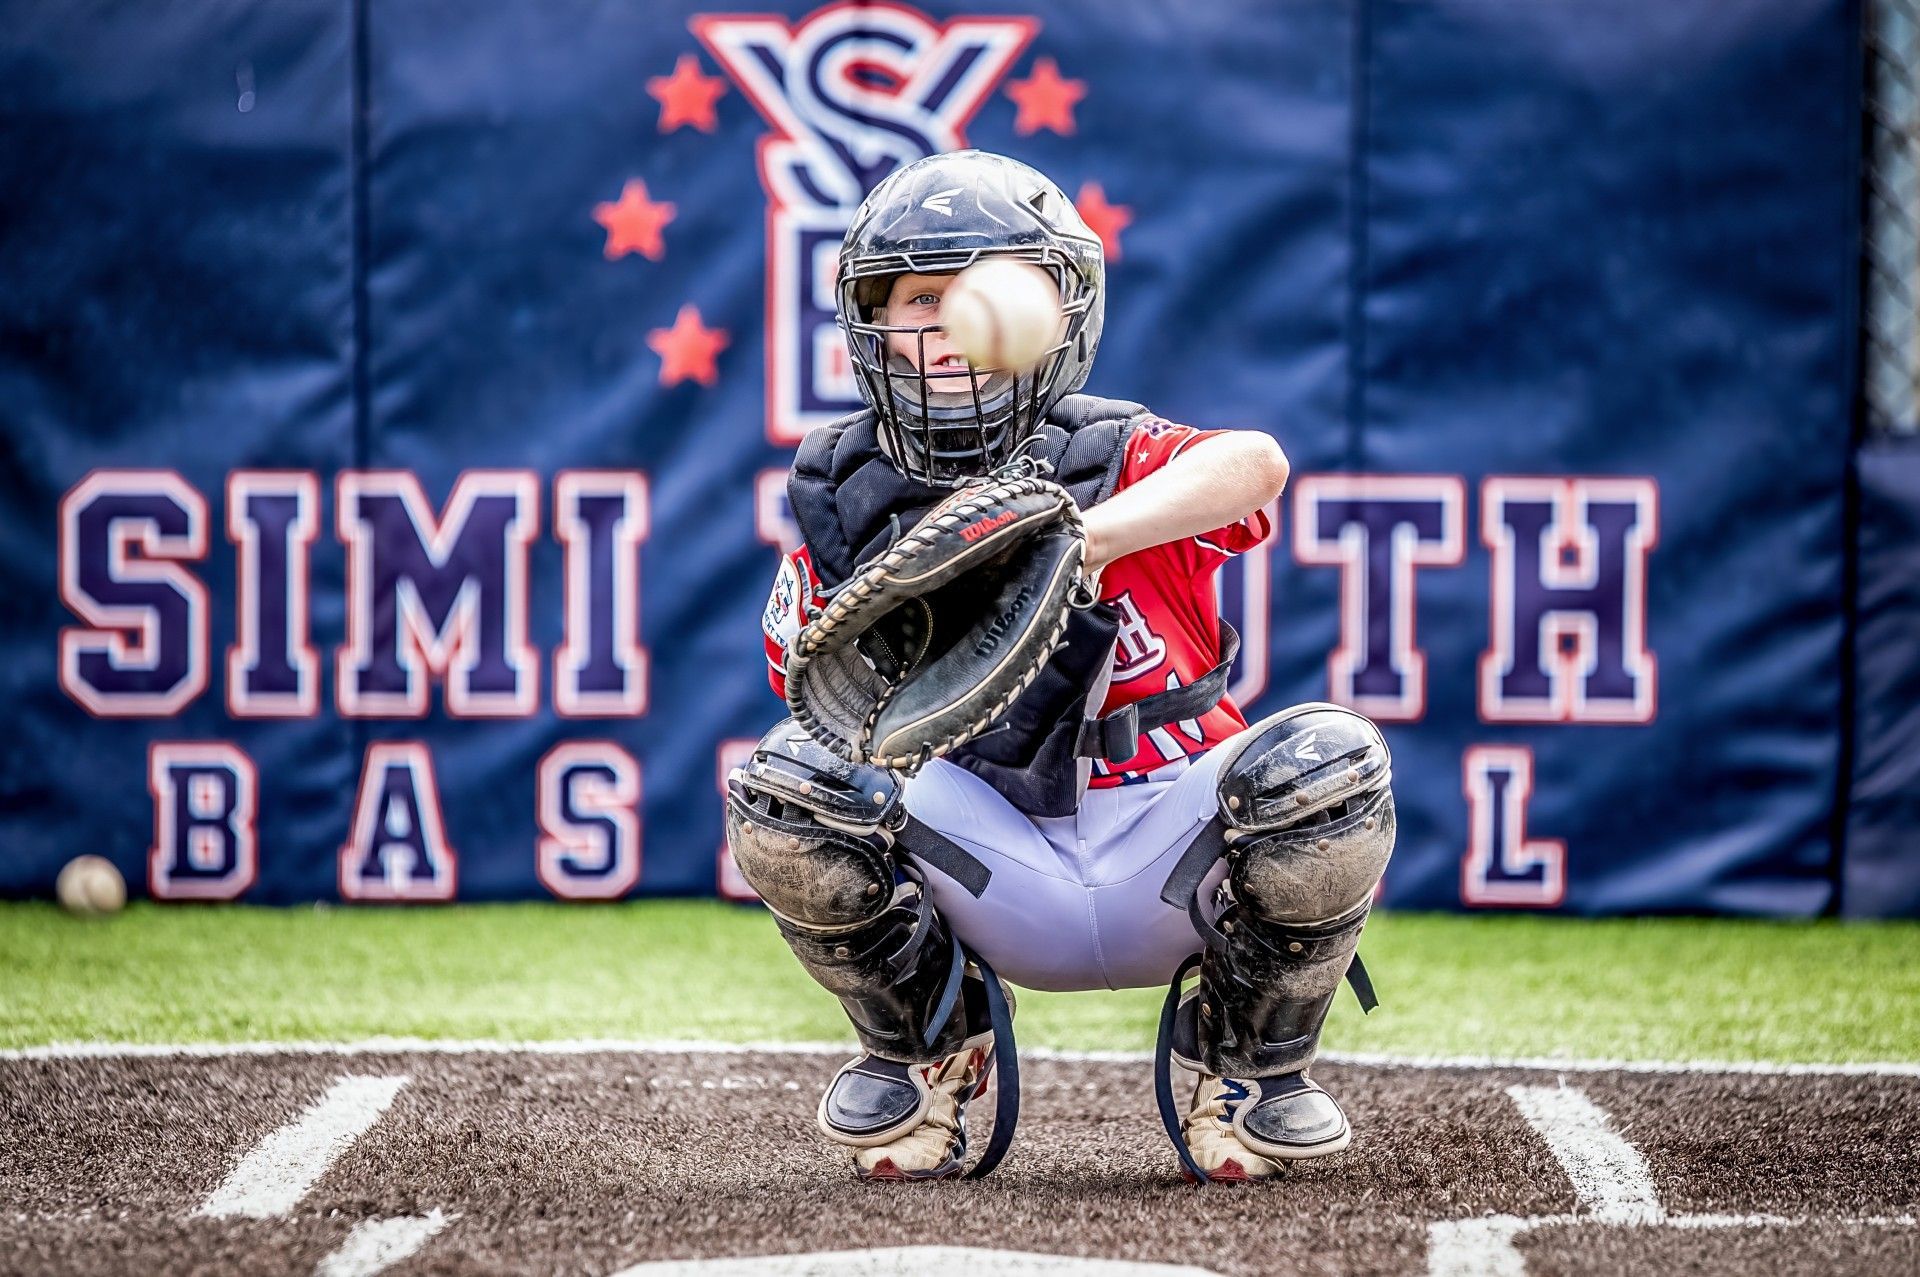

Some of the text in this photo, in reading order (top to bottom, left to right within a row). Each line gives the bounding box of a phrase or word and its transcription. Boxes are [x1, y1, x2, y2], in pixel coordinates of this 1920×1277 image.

[958, 509, 1018, 543] Wilson
[58, 468, 651, 718] SIMI
[974, 586, 1030, 659] Wilson
